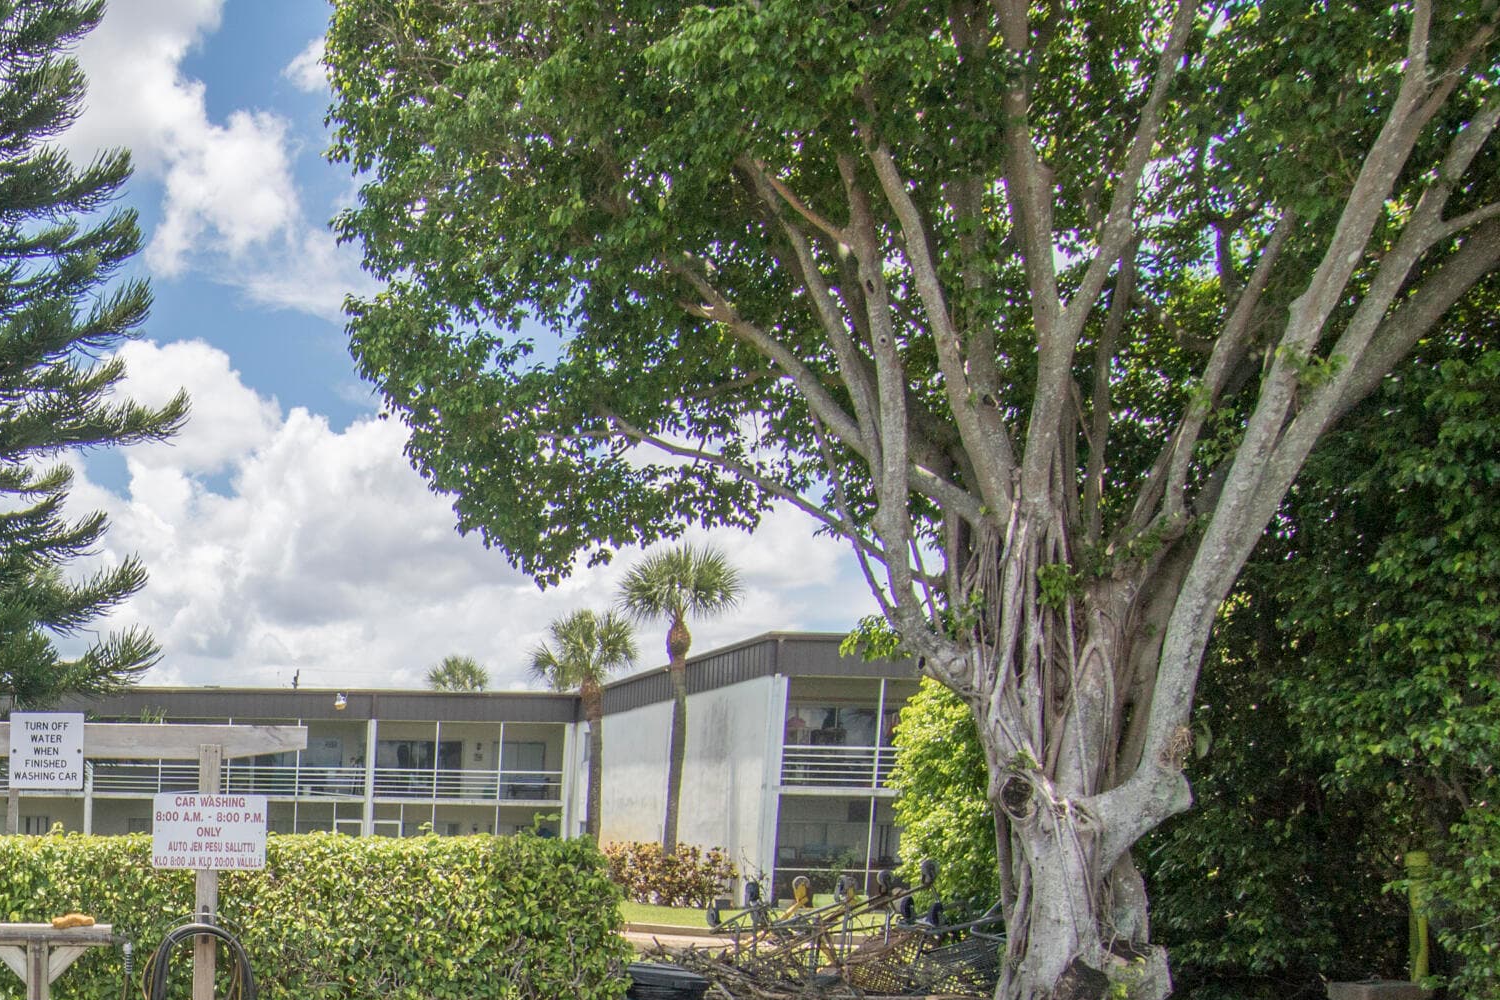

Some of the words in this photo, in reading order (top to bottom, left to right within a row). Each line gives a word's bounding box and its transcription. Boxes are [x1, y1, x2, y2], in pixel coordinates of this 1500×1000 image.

[24, 721, 49, 731] TURN
[51, 721, 69, 731] OFF
[30, 734, 62, 743] WATER
[33, 747, 59, 755] WHEN
[24, 759, 67, 768] FINISHED
[14, 772, 55, 781] WASHING
[58, 772, 77, 781] CAR
[175, 796, 196, 807] CAR
[200, 796, 246, 808] WASHING
[155, 811, 179, 822] 8:00
[183, 811, 204, 822] A.M.
[216, 812, 240, 823] 8:00
[244, 812, 265, 823] P.M.
[196, 826, 222, 837] ONLY
[205, 842, 222, 852] PESU
[225, 842, 256, 853] SALLITTU
[154, 856, 168, 866] KLO
[170, 856, 186, 866] 8:00
[187, 856, 196, 866] JA
[198, 856, 212, 867] KLO
